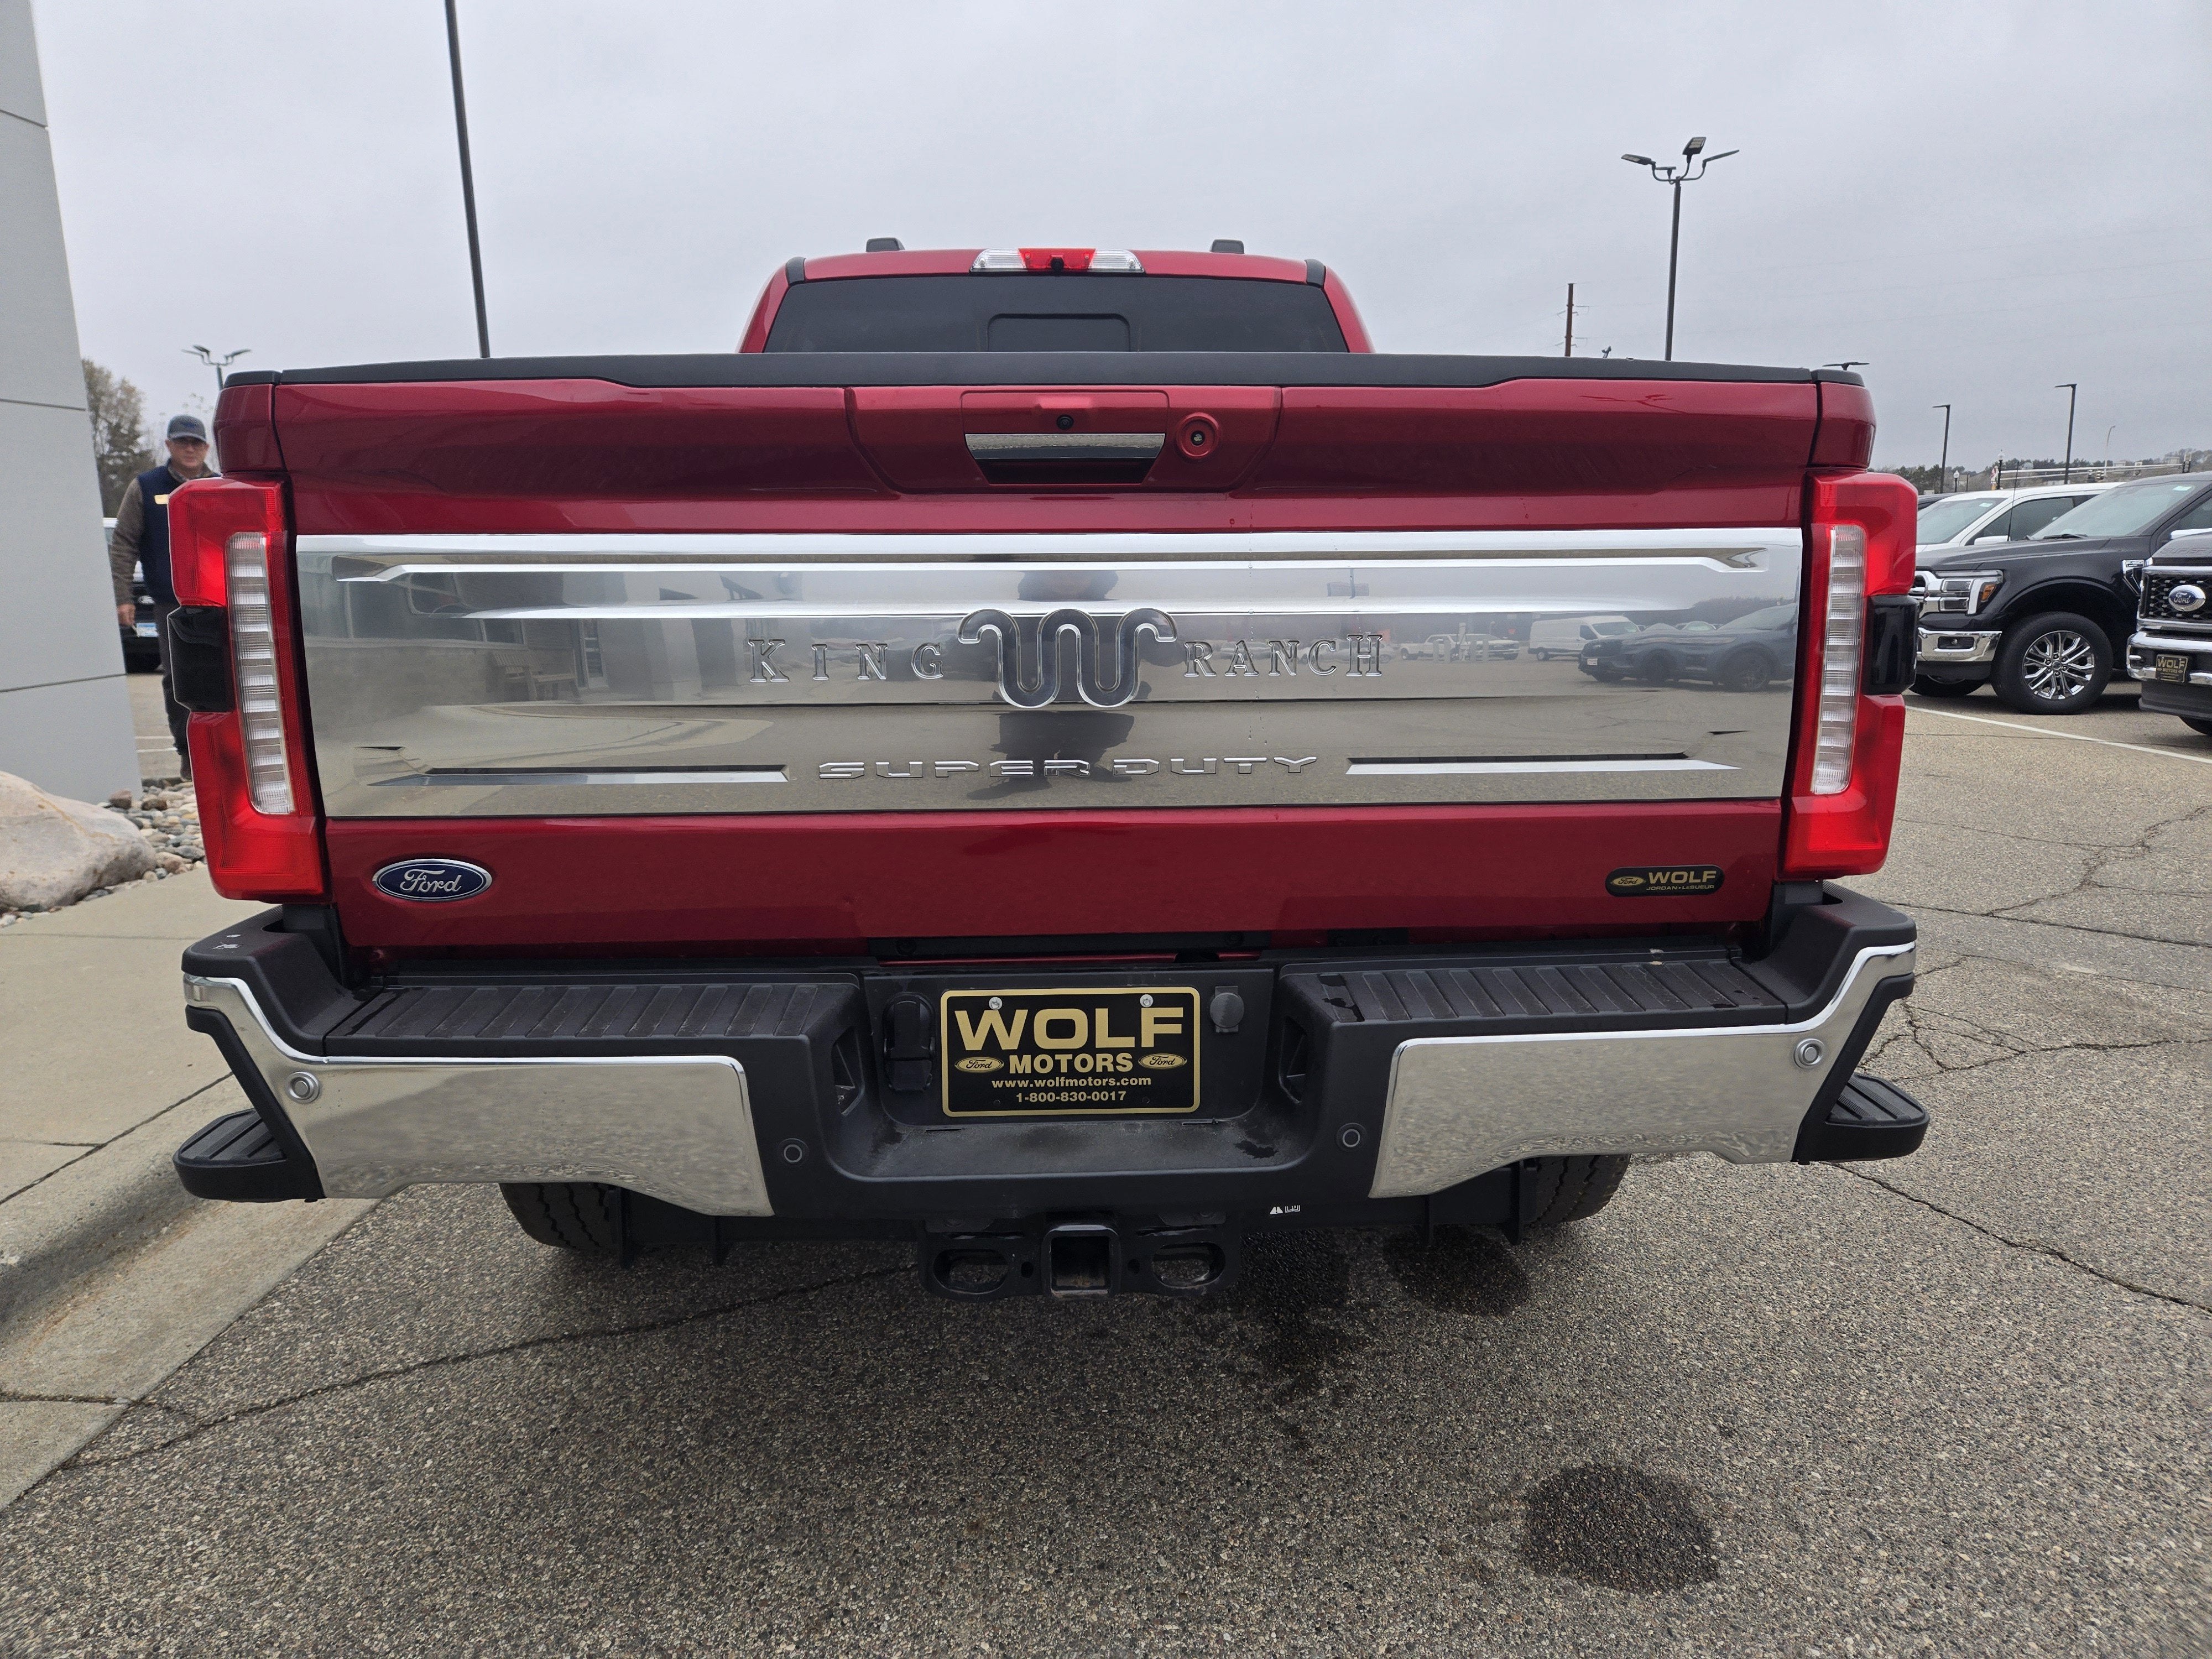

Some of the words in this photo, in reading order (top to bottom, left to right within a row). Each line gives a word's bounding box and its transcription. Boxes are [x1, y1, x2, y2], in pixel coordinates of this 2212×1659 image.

[2174, 592, 2190, 604] Ford
[748, 639, 945, 682] KING
[1185, 634, 1383, 678] RANCH
[2158, 659, 2185, 669] WOLF
[818, 760, 1091, 779] SUPER
[1112, 756, 1317, 775] DUTY
[399, 869, 462, 893] Ford
[1618, 877, 1637, 885] Ford
[1648, 870, 1717, 884] WOLF
[954, 1007, 1183, 1051] WOLF
[966, 1061, 993, 1070] Ford
[1009, 1053, 1134, 1074] MOTORS
[1149, 1057, 1176, 1067] Ford
[992, 1076, 1151, 1088] www.wolfmotors.com
[1016, 1091, 1126, 1103] 1-800-830-0017
